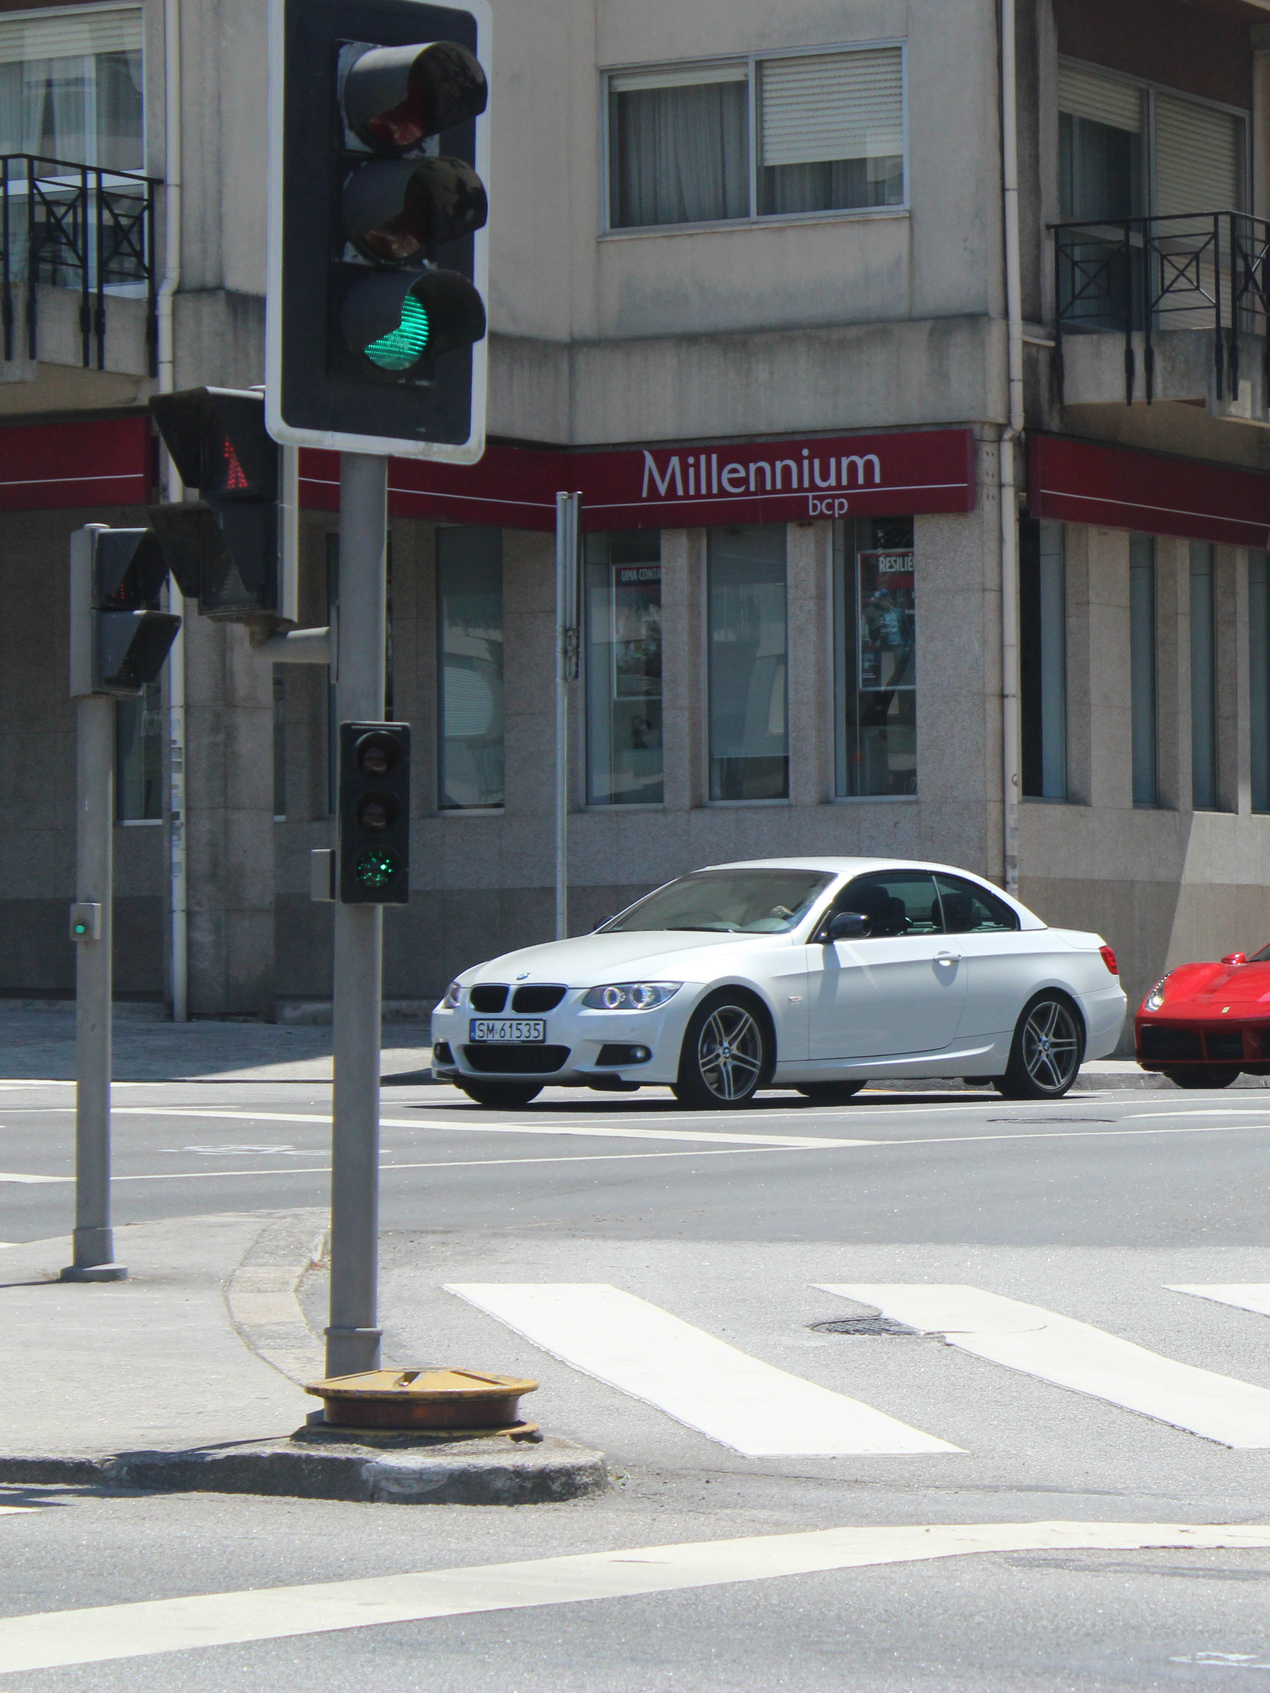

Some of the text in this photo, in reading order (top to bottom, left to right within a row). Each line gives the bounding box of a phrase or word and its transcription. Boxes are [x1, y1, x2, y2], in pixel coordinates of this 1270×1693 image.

[641, 449, 881, 498] Millennium
[808, 495, 848, 517] bcp
[621, 569, 638, 581] UMA
[477, 1022, 541, 1039] SM 61535
